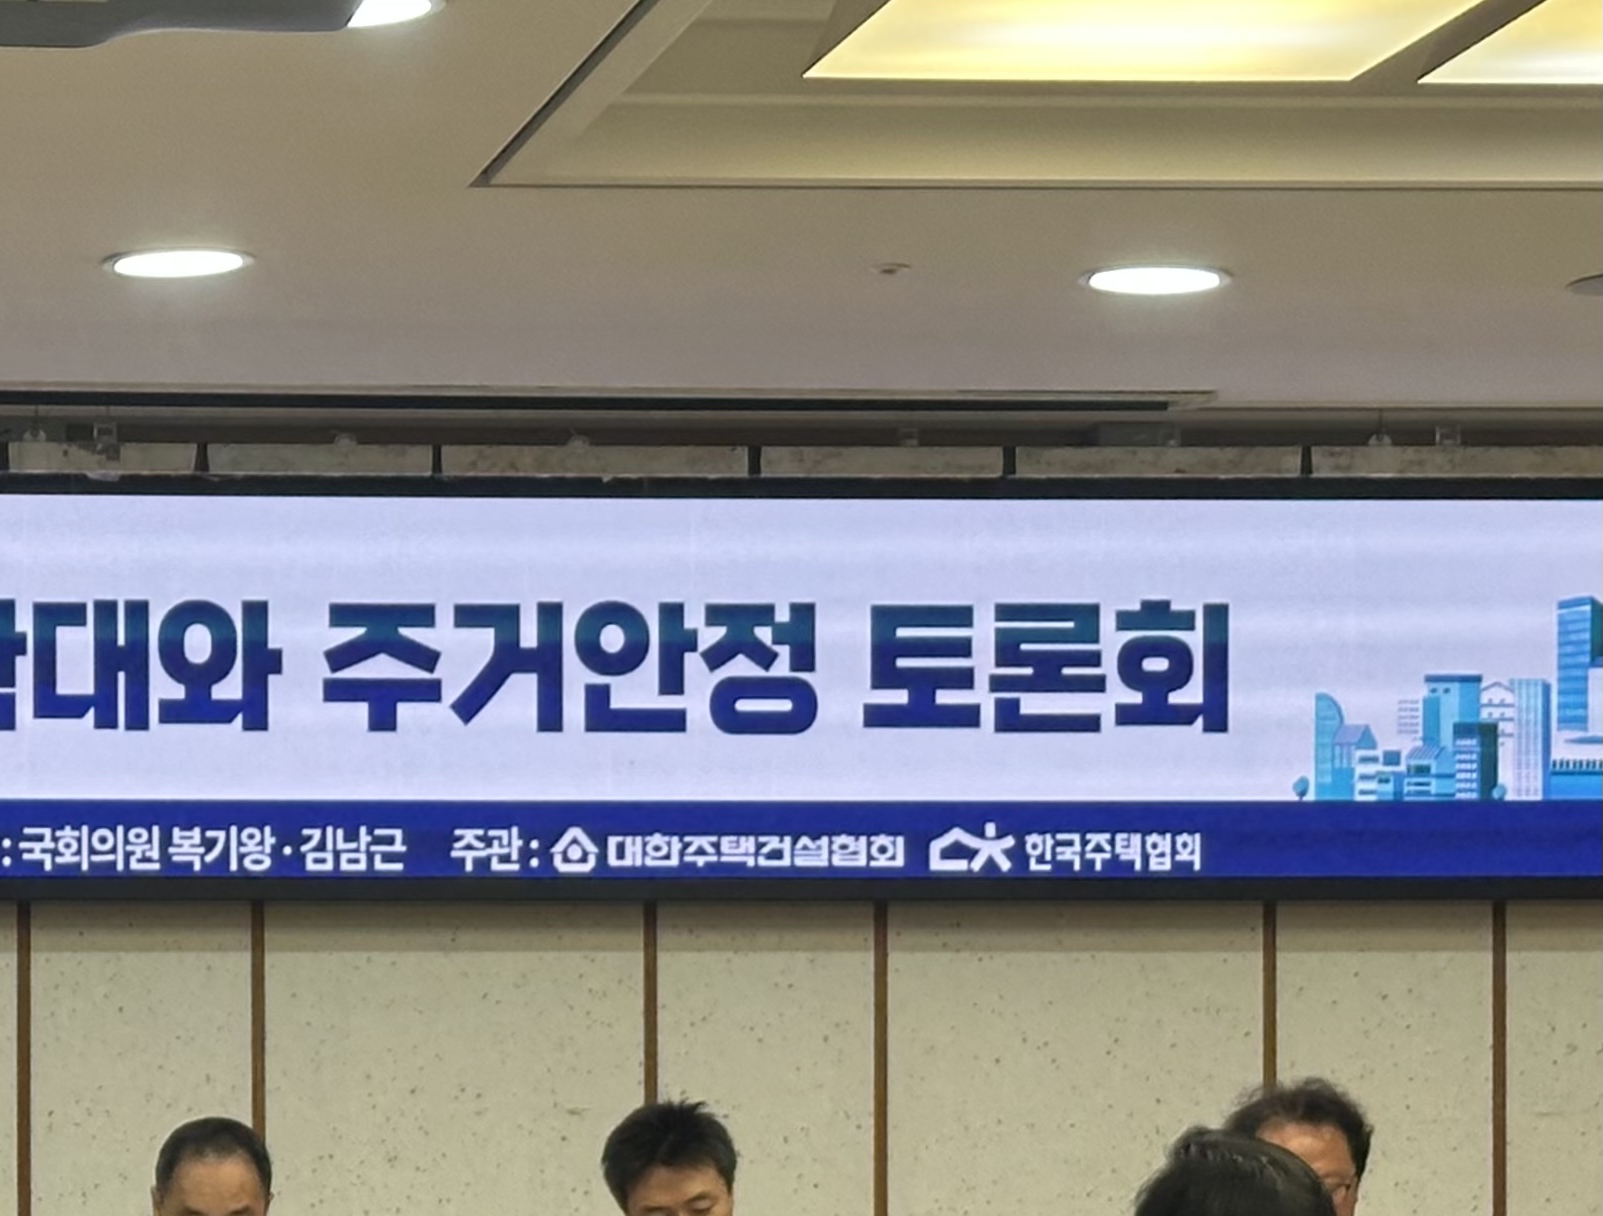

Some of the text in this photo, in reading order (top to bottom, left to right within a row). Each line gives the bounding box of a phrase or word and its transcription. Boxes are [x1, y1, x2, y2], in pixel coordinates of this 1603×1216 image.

[322, 600, 819, 736] 주거안정
[862, 599, 1230, 734] 토론회
[18, 824, 161, 872] 국회의원
[450, 825, 523, 873] 주관
[607, 832, 905, 868] 대한주택건설협회
[1024, 832, 1201, 872] 한국주택협회
